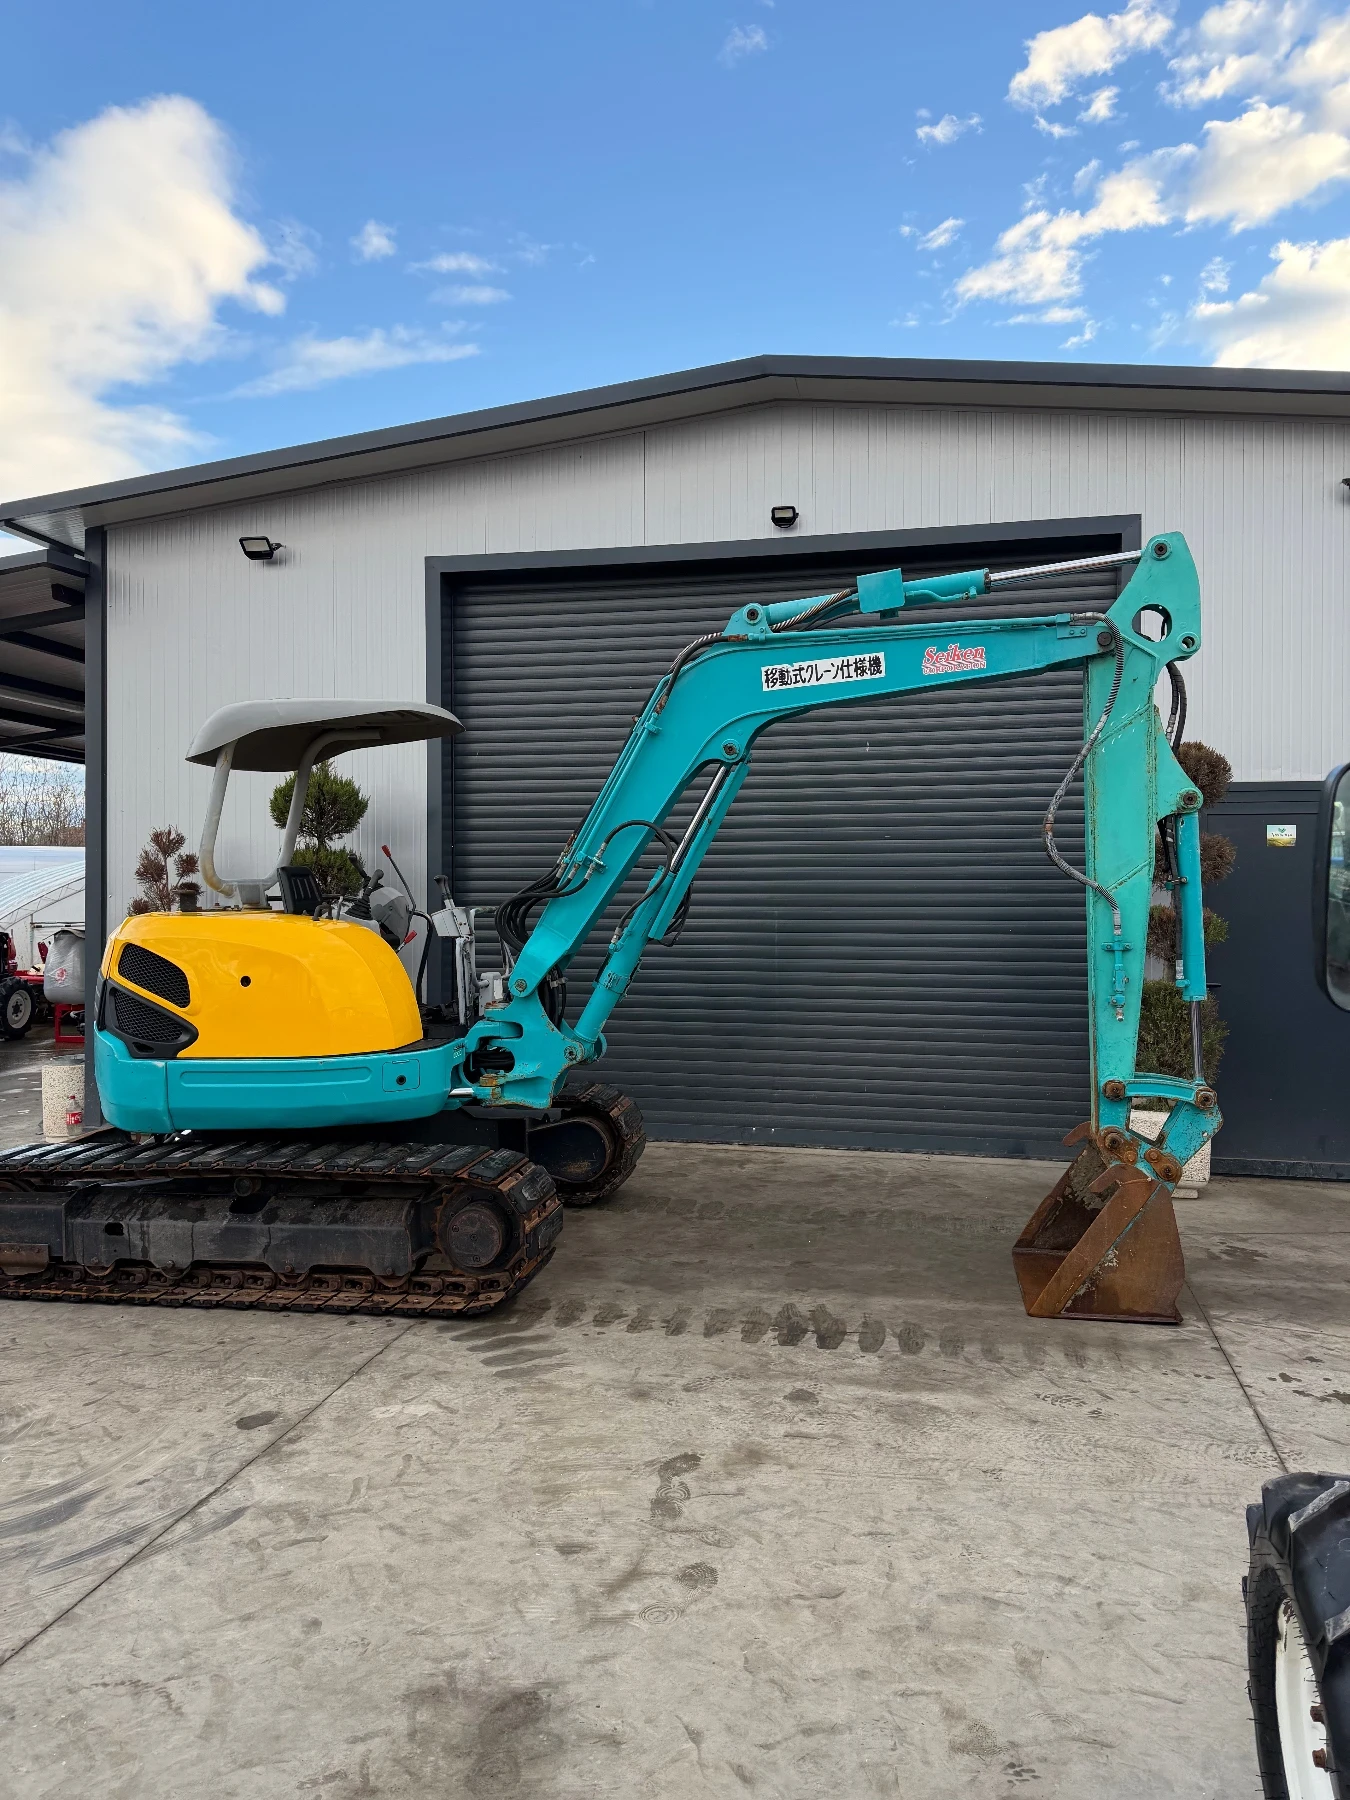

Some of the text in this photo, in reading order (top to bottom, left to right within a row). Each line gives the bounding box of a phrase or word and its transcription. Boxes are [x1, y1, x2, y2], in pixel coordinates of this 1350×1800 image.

[923, 643, 985, 664] Seiken
[764, 655, 882, 688] 移動式クレーン仕様機
